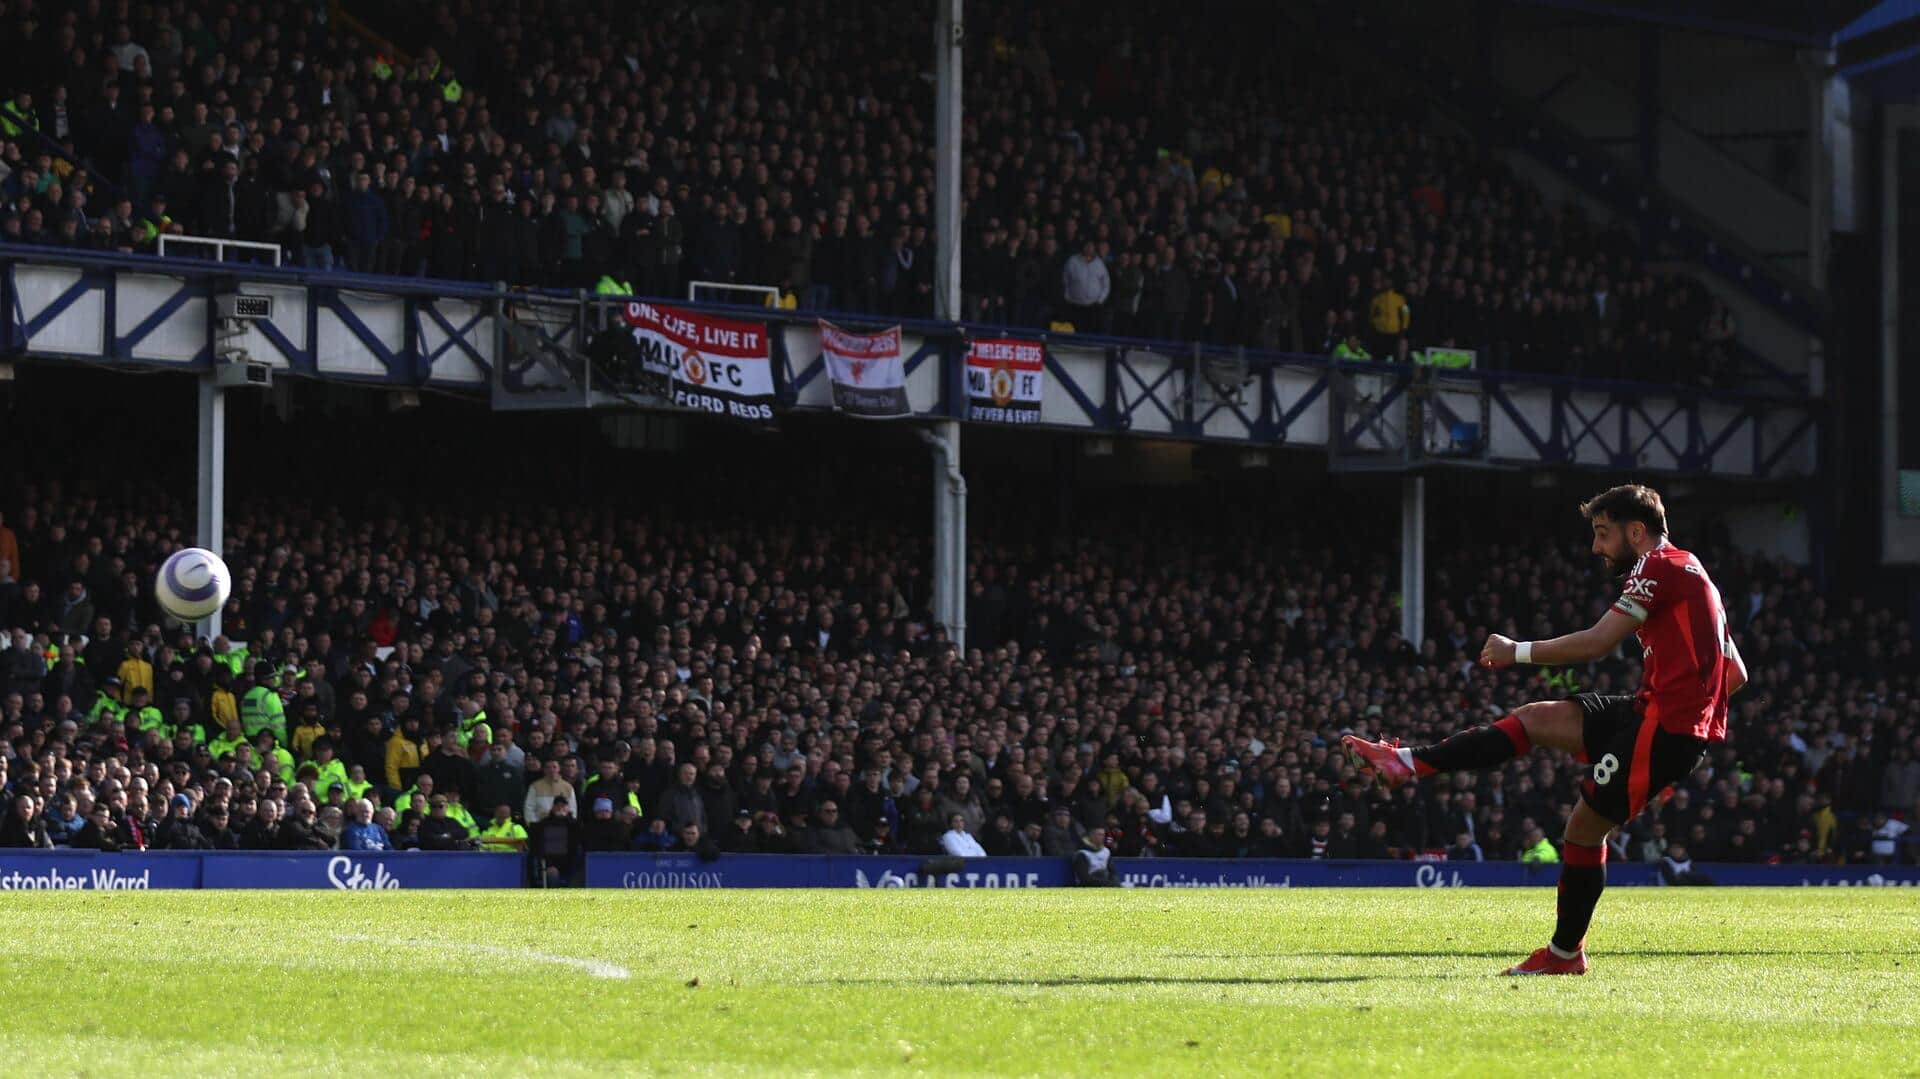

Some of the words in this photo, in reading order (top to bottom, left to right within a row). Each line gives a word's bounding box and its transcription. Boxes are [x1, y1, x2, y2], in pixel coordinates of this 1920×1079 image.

[628, 301, 660, 325] ONE
[703, 326, 741, 349] LIVE
[743, 332, 760, 349] IT
[675, 389, 726, 415] FORD
[728, 400, 774, 420] REDS
[1594, 753, 1619, 785] 8
[91, 869, 150, 890] Ward
[623, 871, 723, 889] GOODISON
